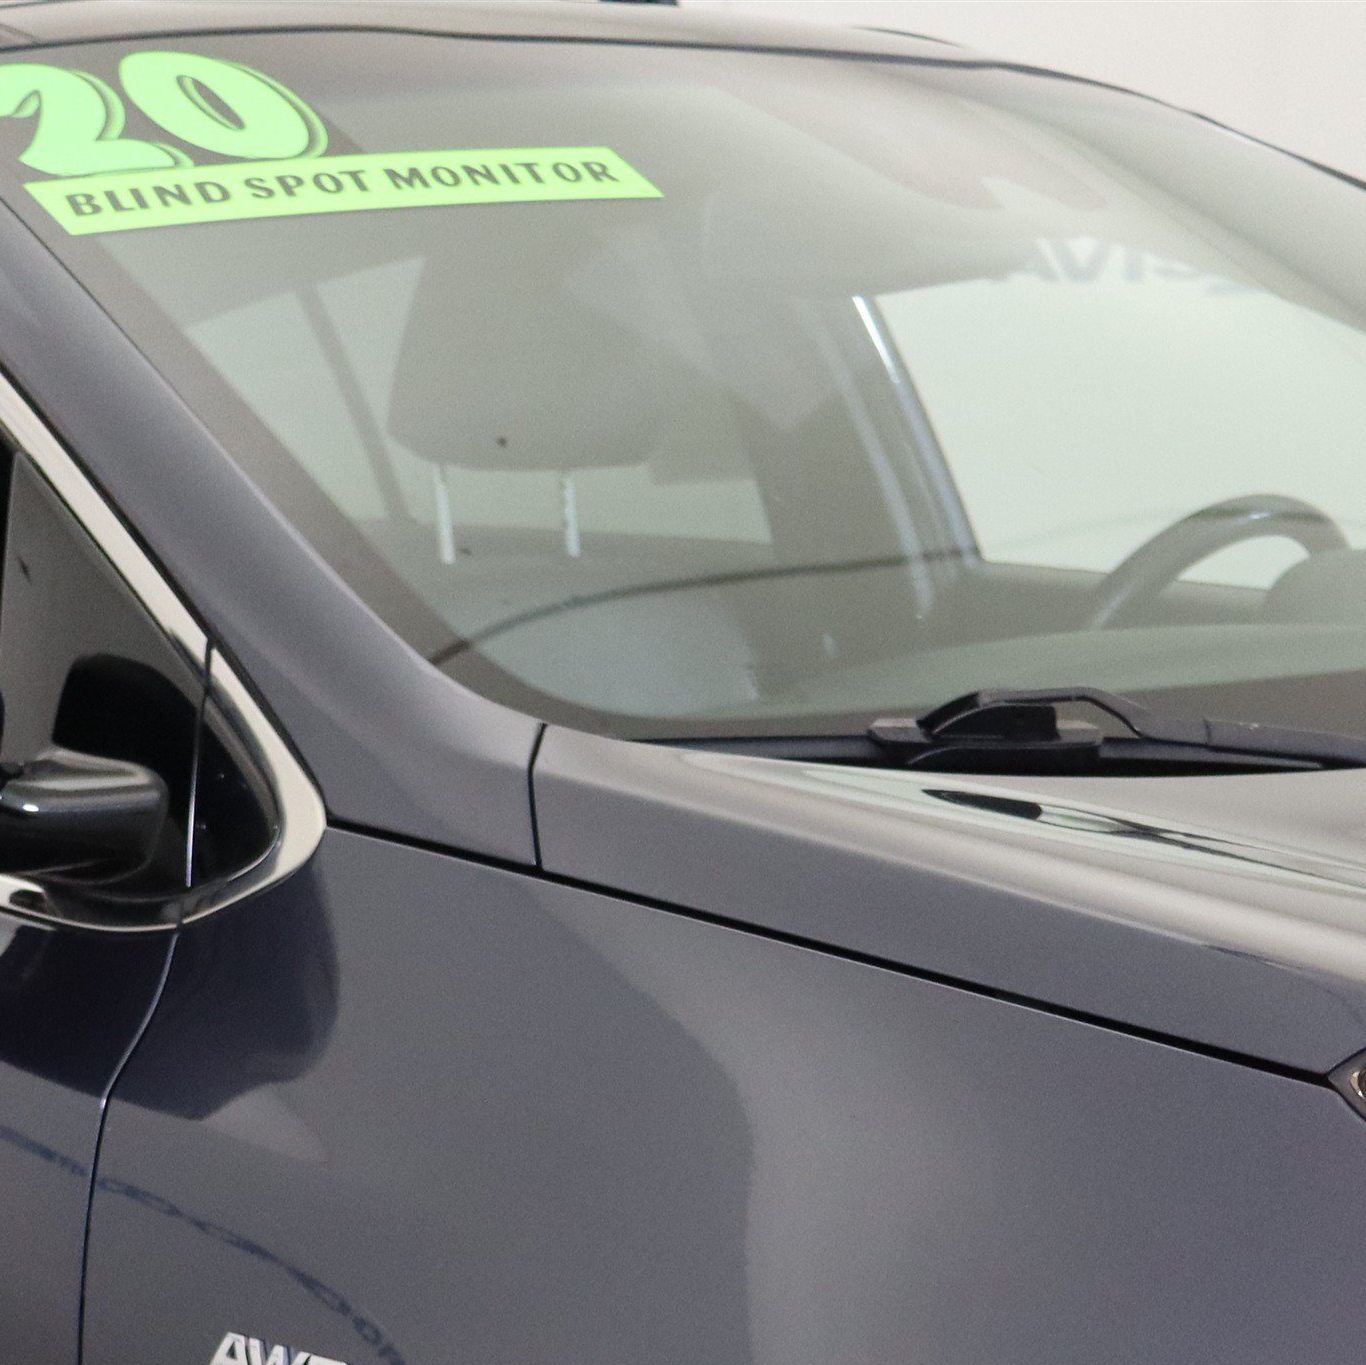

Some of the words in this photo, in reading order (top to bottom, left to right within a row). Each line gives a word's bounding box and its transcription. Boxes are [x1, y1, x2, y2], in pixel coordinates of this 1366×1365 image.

[65, 180, 231, 218] BLIND
[250, 169, 370, 200] SPOT
[389, 159, 621, 191] MONITOR
